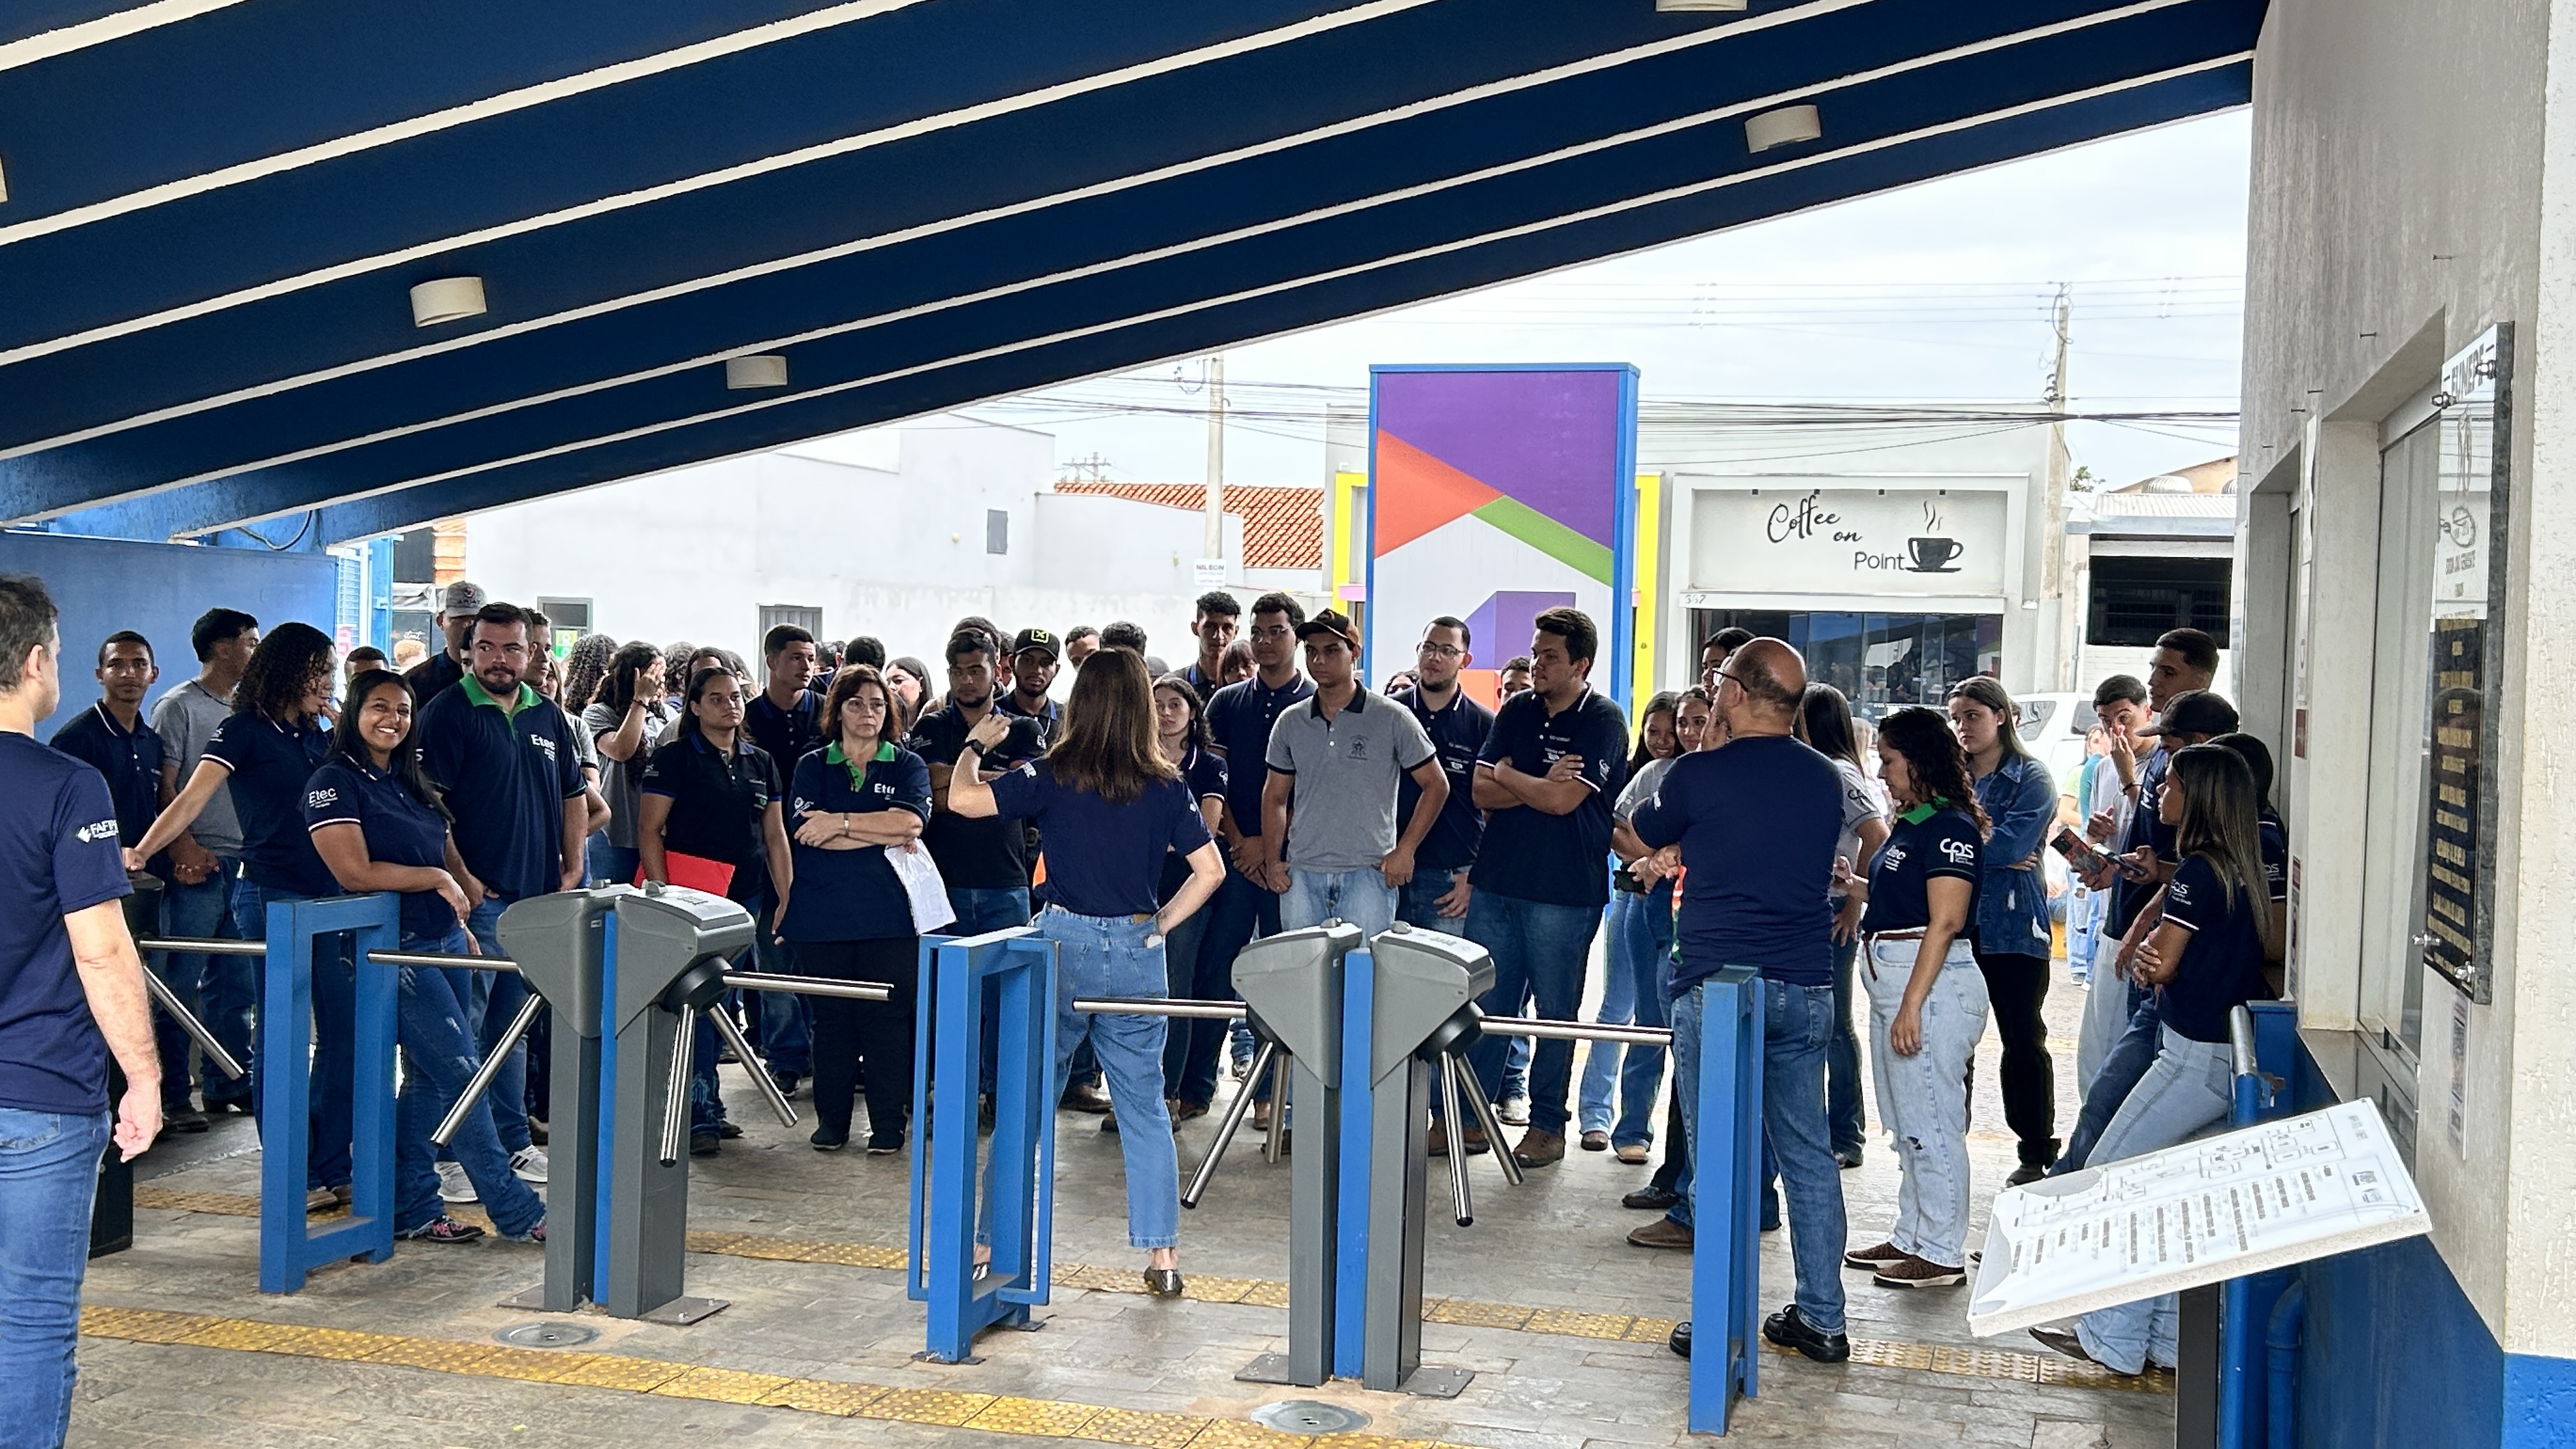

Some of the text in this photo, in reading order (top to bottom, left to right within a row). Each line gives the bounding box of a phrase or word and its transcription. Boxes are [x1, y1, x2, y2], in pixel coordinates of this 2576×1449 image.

[1767, 494, 1841, 543] Coffee
[1833, 531, 1863, 542] on
[1854, 551, 1906, 571] Point
[309, 788, 337, 804] Etec
